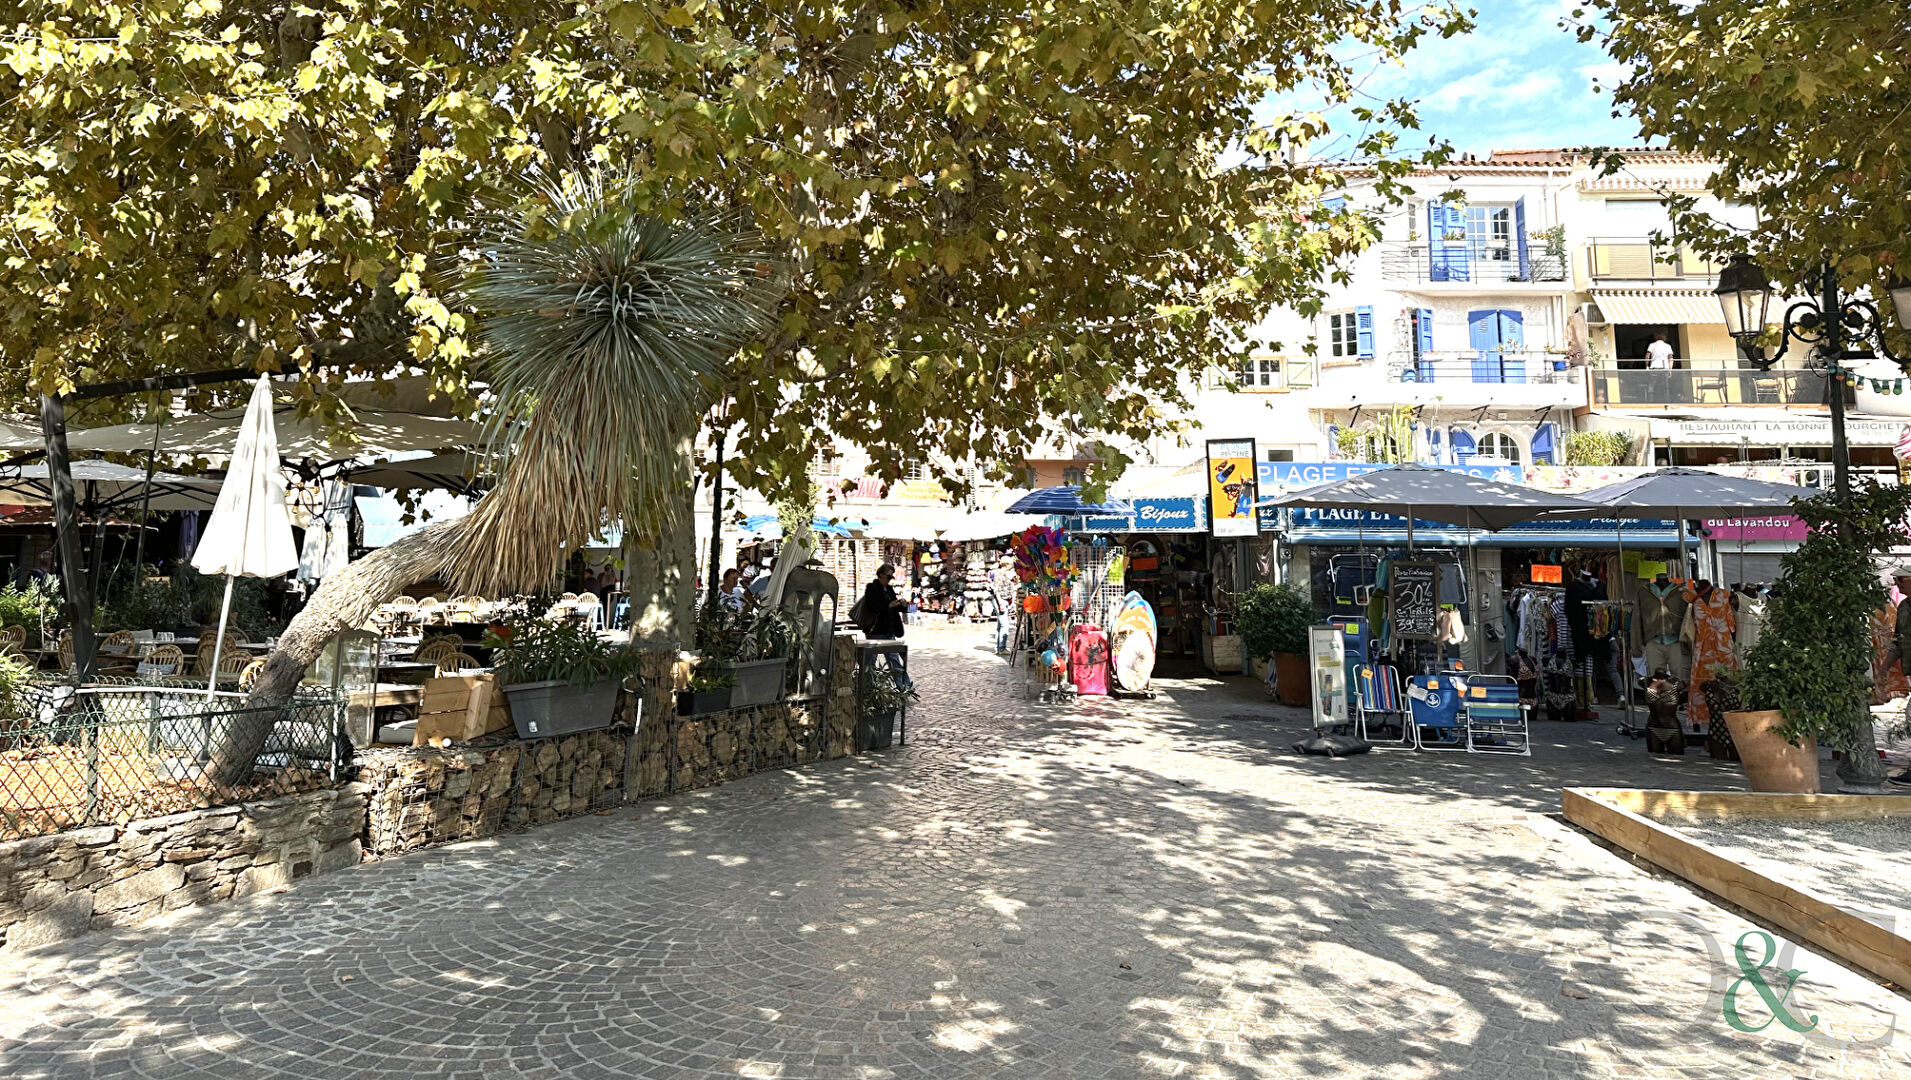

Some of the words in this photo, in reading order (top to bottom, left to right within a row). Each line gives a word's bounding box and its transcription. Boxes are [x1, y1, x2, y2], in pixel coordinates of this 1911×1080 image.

[1680, 423, 1757, 431] RESTAURANT
[1766, 423, 1781, 431] LA
[1787, 423, 1829, 431] BONNE
[1257, 465, 1336, 483] PLAGE
[1139, 505, 1189, 524] Bijoux
[1304, 507, 1365, 521] PLAGE
[1707, 518, 1724, 527] du
[1727, 516, 1790, 527] Lavandou
[1394, 581, 1433, 608] 30%
